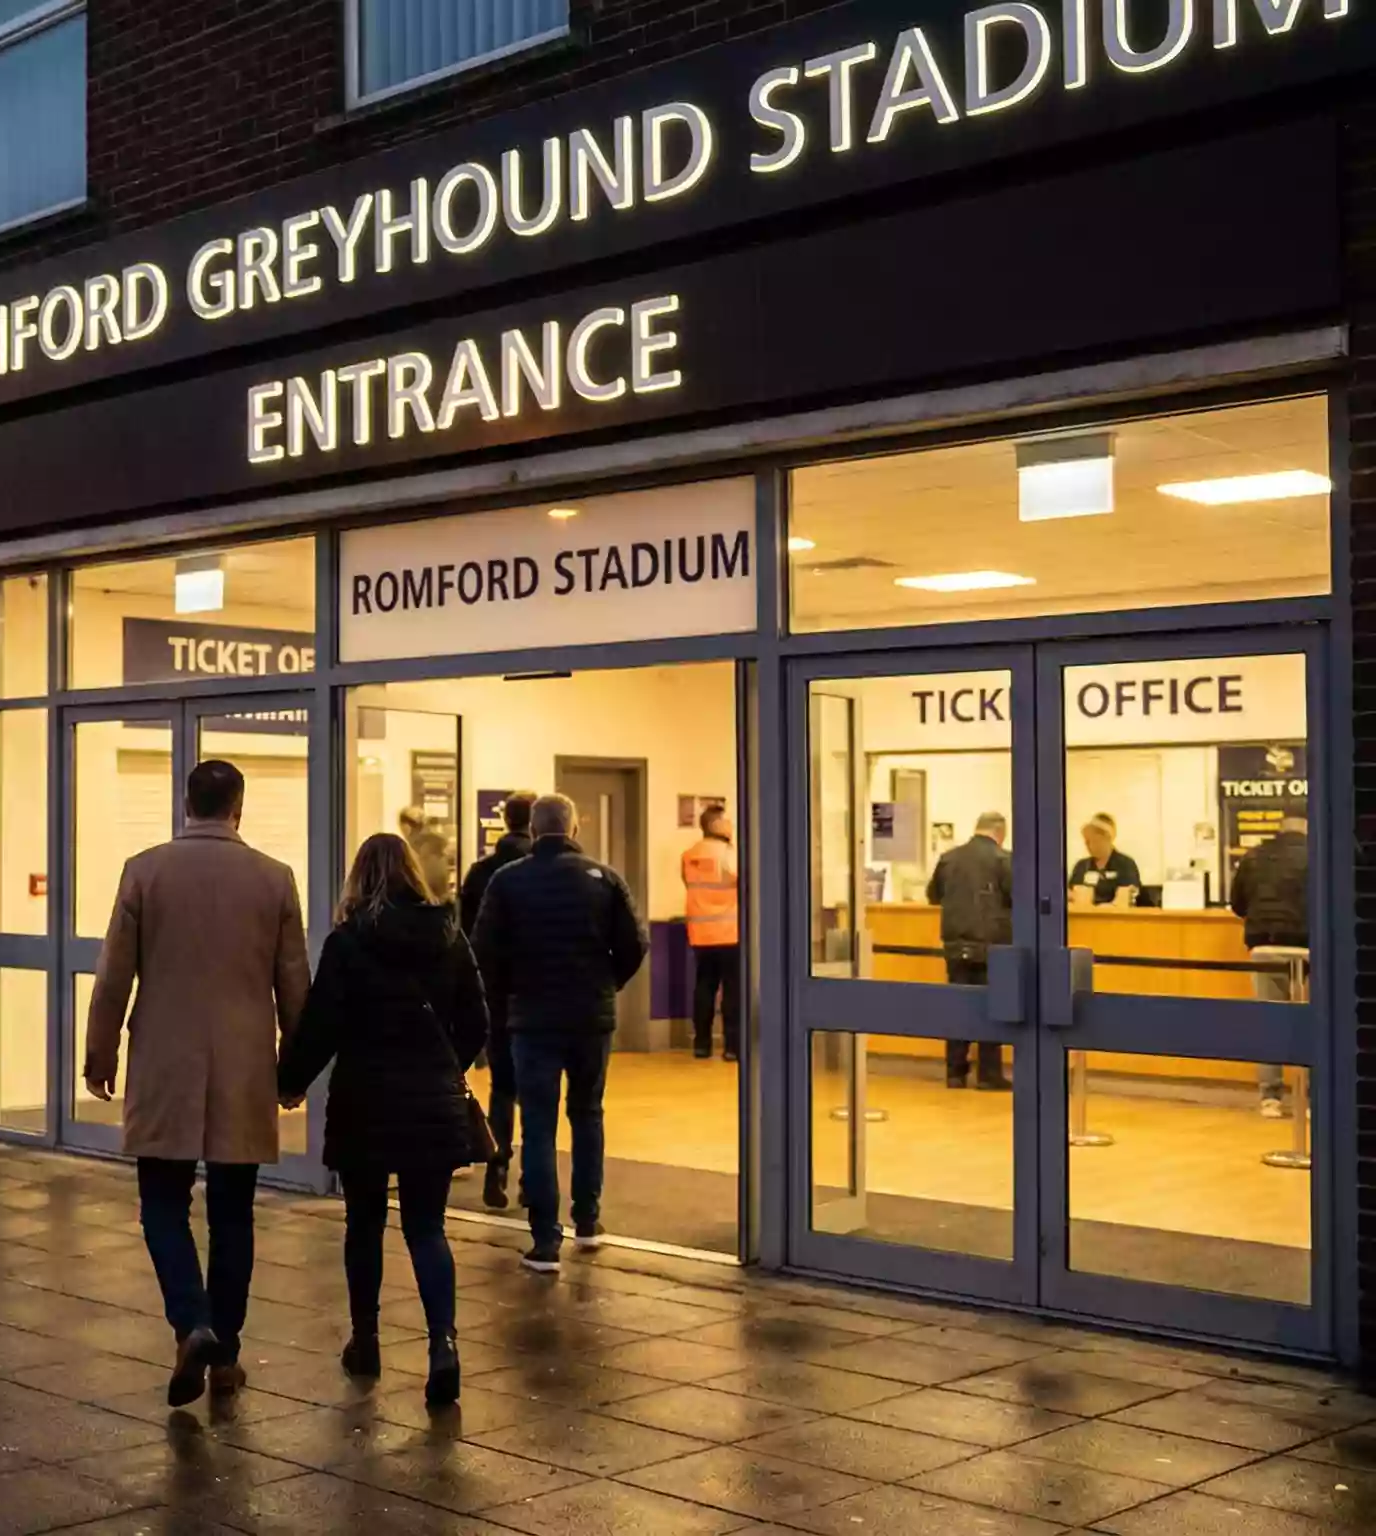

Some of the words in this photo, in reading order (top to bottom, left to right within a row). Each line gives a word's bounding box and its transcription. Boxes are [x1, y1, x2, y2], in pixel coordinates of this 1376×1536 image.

[186, 101, 714, 320] GREYHOUND
[247, 294, 683, 465] ENTRANCE
[352, 556, 540, 616] ROMFORD
[553, 530, 751, 596] STADIUM
[168, 636, 272, 676] TICKET
[912, 687, 1012, 724] TICK
[1077, 674, 1243, 718] OFFICE
[1221, 780, 1286, 797] TICKET
